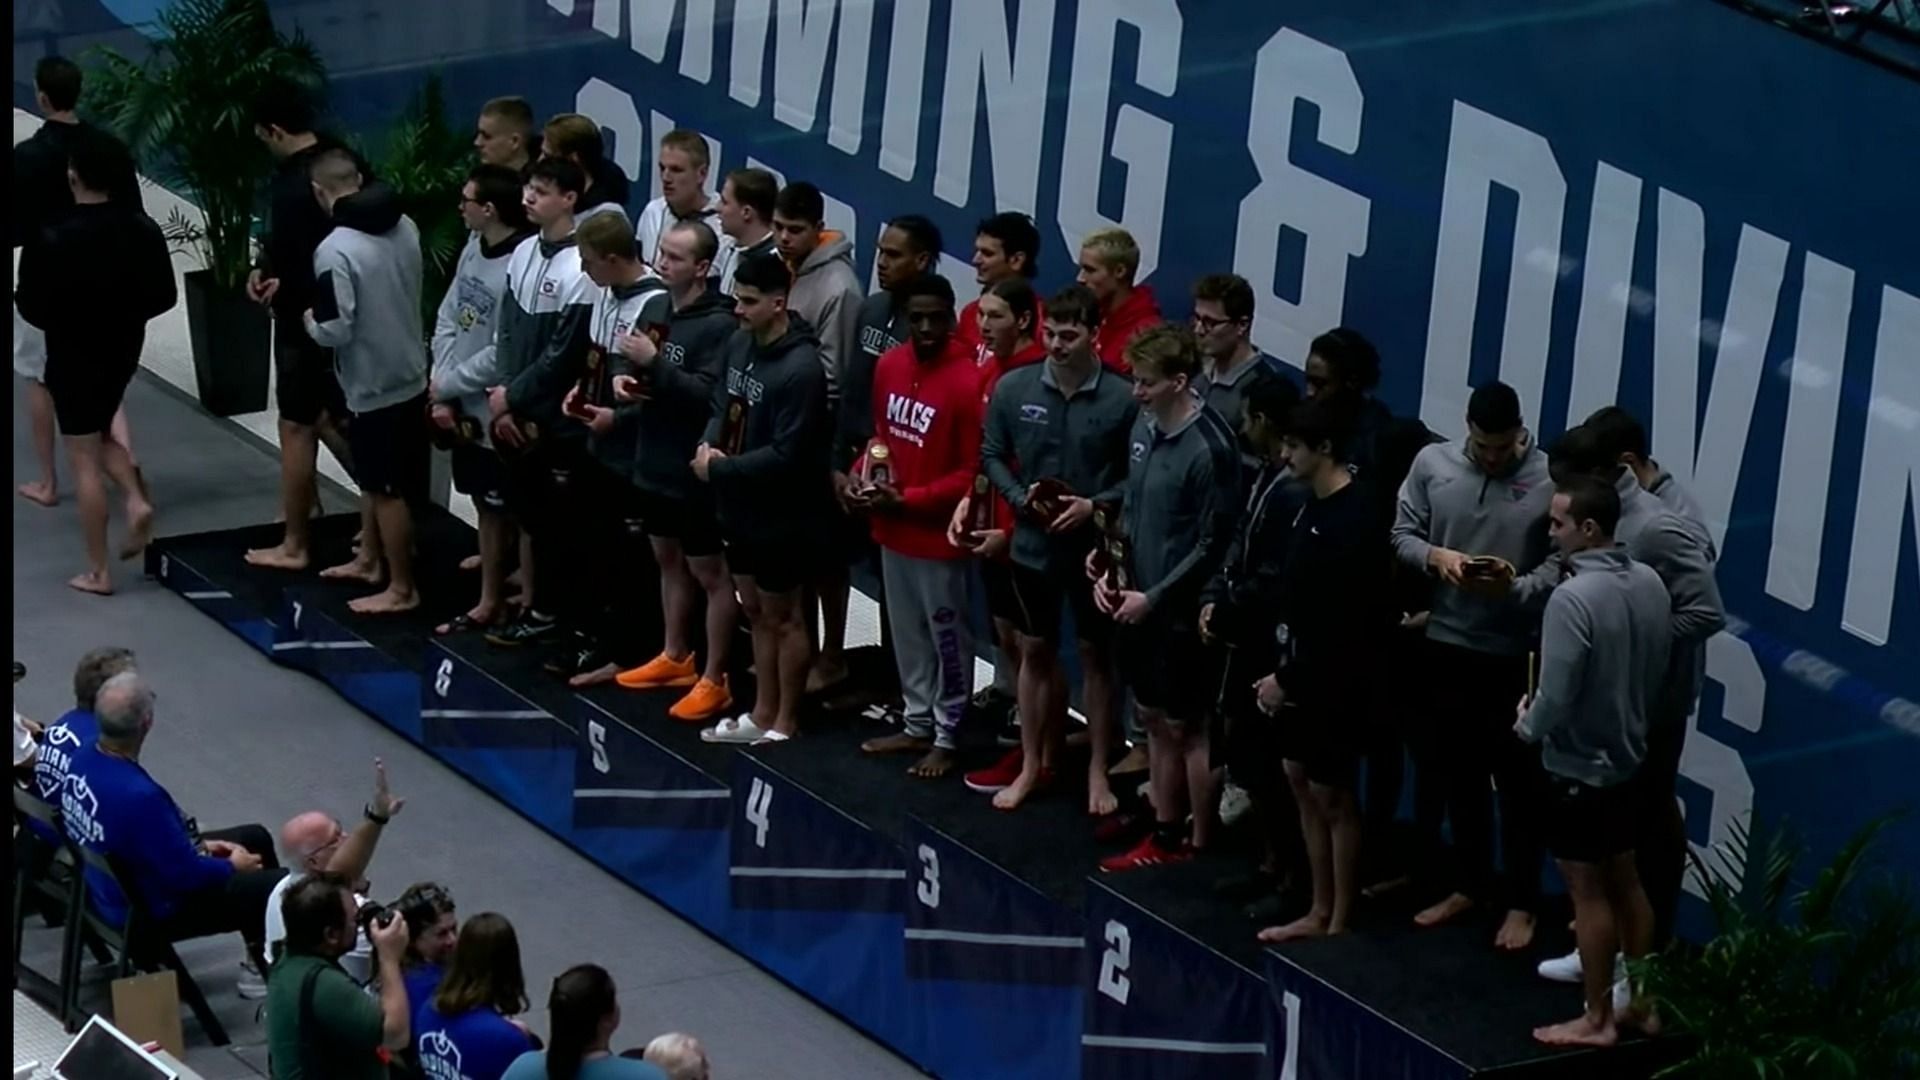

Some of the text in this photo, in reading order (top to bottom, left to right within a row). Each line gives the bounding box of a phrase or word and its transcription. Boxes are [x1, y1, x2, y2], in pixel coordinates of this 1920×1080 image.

[1232, 26, 1372, 371] &
[292, 601, 303, 631] 7
[434, 658, 453, 698] 6
[588, 719, 611, 774] 5
[745, 776, 774, 849] 4
[917, 843, 940, 909] 3
[1097, 918, 1132, 1006] 2
[1279, 989, 1301, 1080] 1
